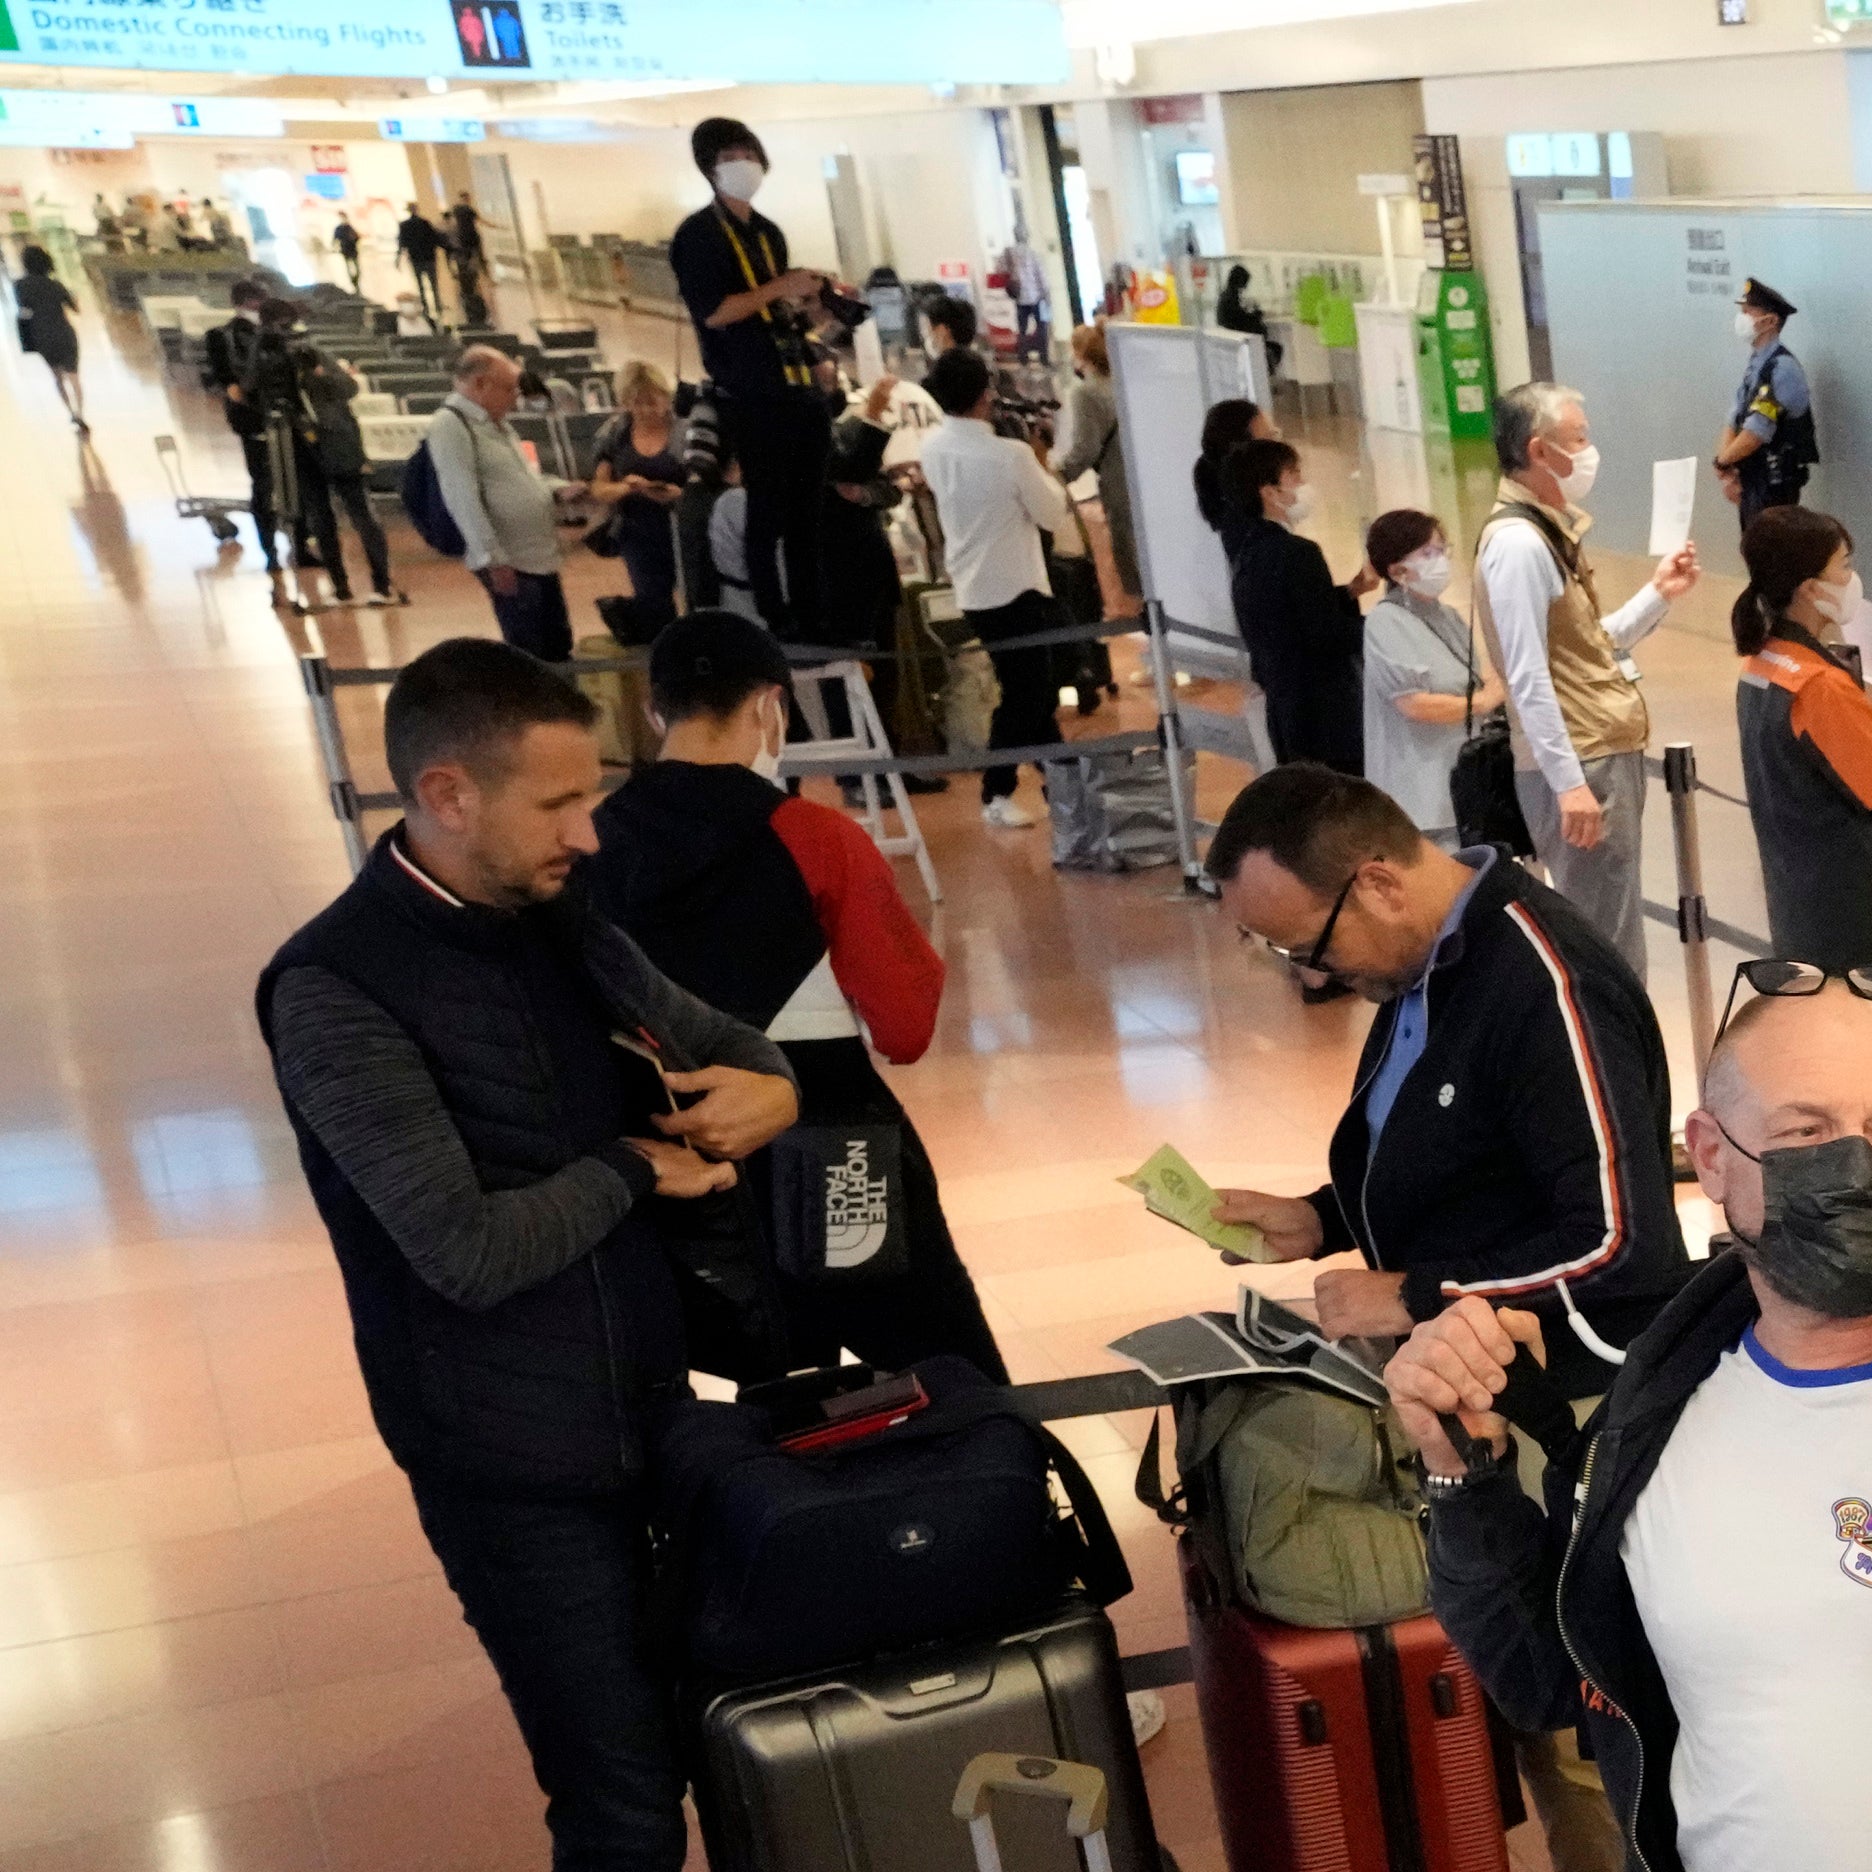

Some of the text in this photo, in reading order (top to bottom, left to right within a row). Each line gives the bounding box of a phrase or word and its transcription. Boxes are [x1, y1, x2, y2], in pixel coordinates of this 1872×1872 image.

[32, 10, 427, 48] Domestic Connecting Flights
[546, 31, 623, 50] Toilets
[826, 1165, 848, 1226] FACE
[846, 1141, 868, 1223] NORTH
[868, 1175, 887, 1223] THE
